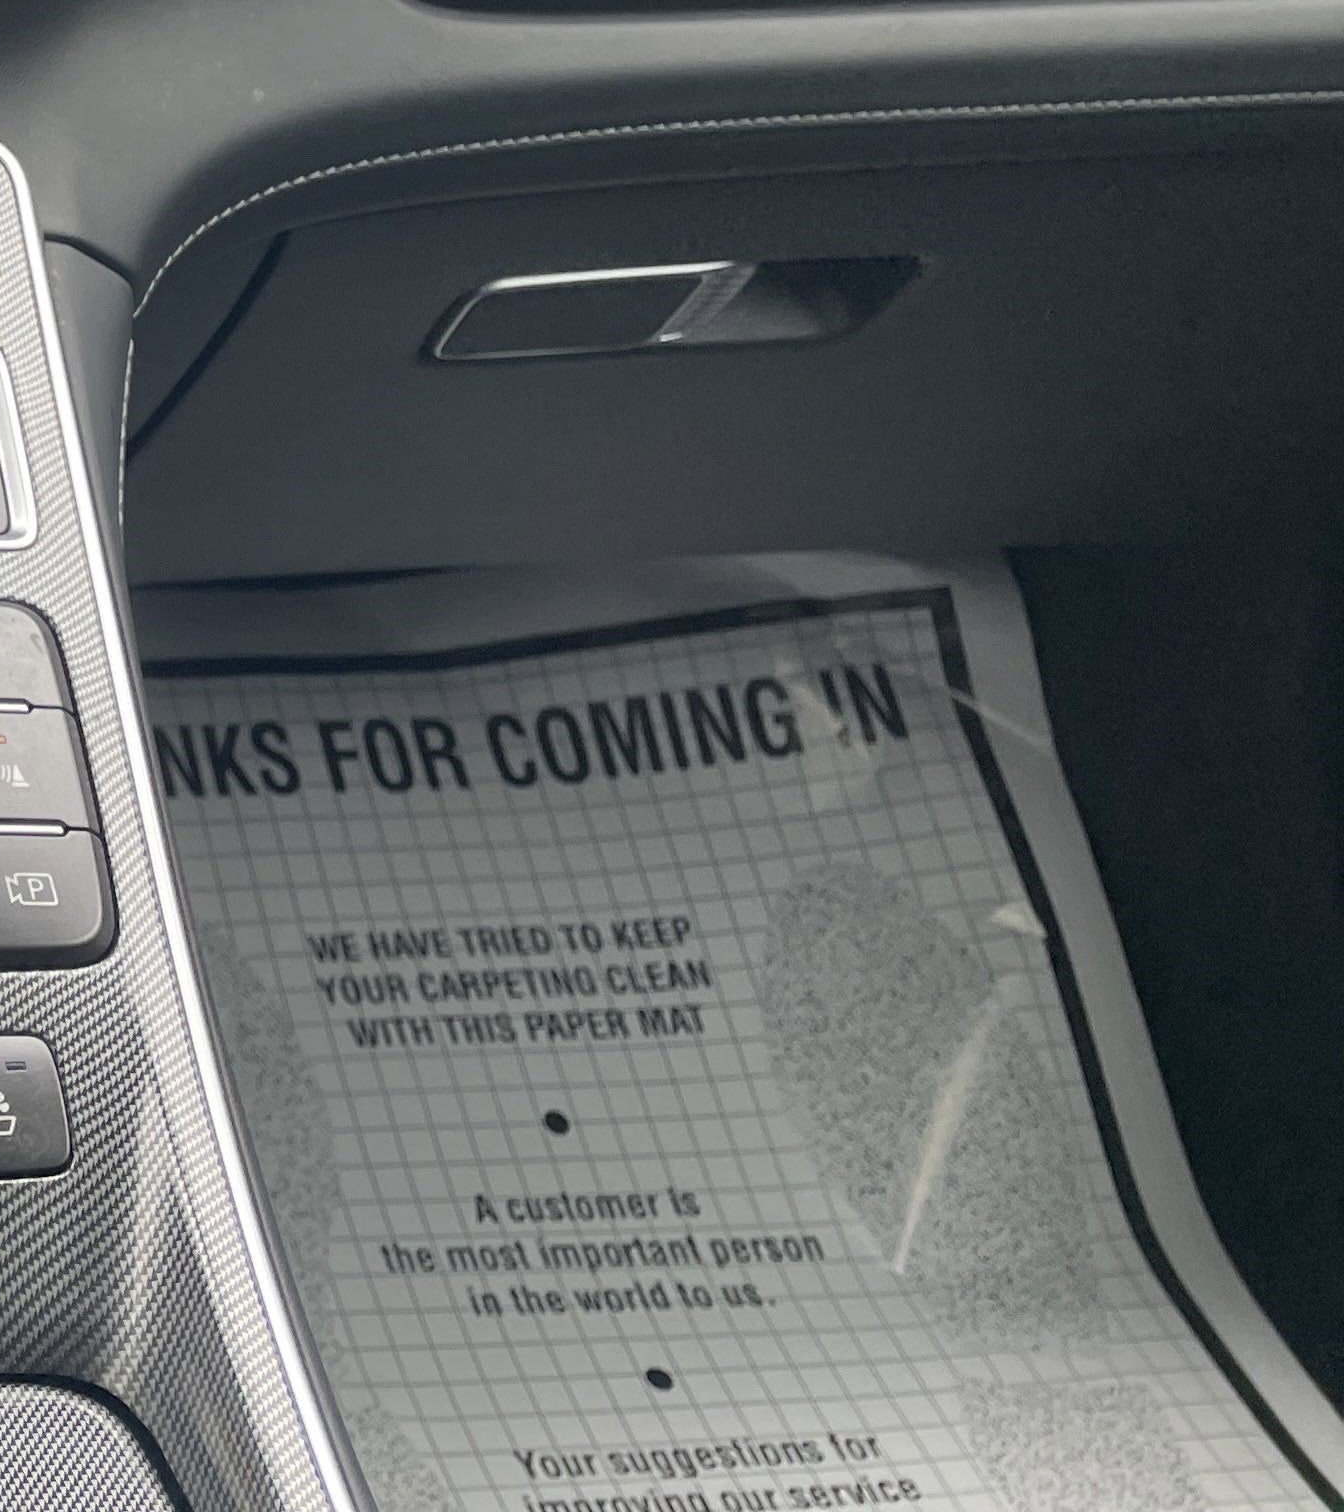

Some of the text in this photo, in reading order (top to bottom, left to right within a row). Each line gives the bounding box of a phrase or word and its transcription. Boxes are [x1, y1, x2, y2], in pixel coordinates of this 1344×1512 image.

[318, 715, 470, 794] FOR
[486, 675, 803, 786] COMING
[307, 914, 692, 964] WE HAVE TRIED TO KEEP
[316, 960, 712, 1007] YOUR CARPETING CLEAN
[348, 1004, 706, 1049] WITH THIS PAPER MAT
[474, 1188, 701, 1224] A customer is
[381, 1233, 825, 1274] the most important person
[469, 1280, 777, 1317] in the world to us.
[513, 1431, 880, 1481] Your suggestions for
[523, 1476, 923, 1512] improving our service
